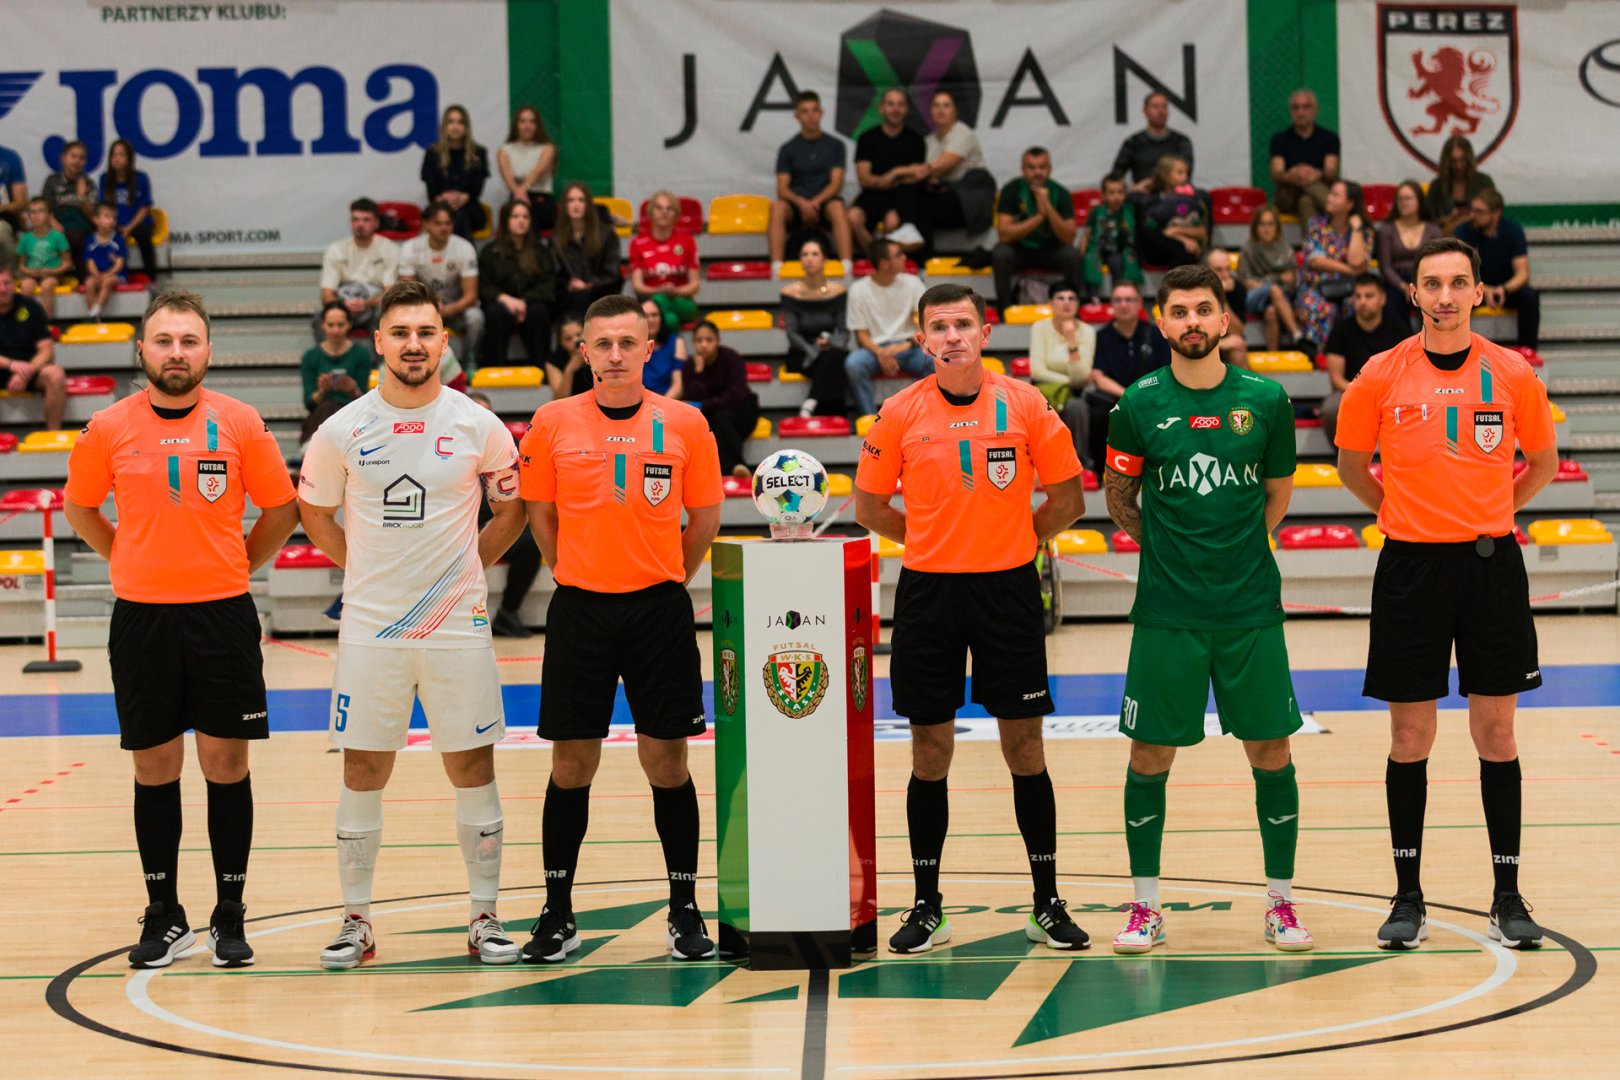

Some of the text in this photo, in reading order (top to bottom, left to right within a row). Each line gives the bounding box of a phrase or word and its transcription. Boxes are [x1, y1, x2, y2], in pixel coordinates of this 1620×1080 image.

[102, 4, 287, 22] PARTNERZY KLUBU:
[1388, 11, 1506, 30] PEREZ
[1475, 414, 1502, 422] FUTSAL
[988, 450, 1014, 459] FUTSAL
[199, 463, 226, 471] FUTSAL
[1114, 455, 1130, 471] C
[645, 466, 671, 475] FUTSAL
[1159, 452, 1259, 496] JAXAN
[766, 475, 810, 489] SELECT
[767, 610, 826, 629] JAXAN
[773, 641, 817, 651] FUTSAL
[242, 711, 267, 721] zina
[335, 693, 351, 732] 5
[911, 857, 937, 866] ina
[222, 873, 246, 882] zin
[543, 870, 567, 878] ina
